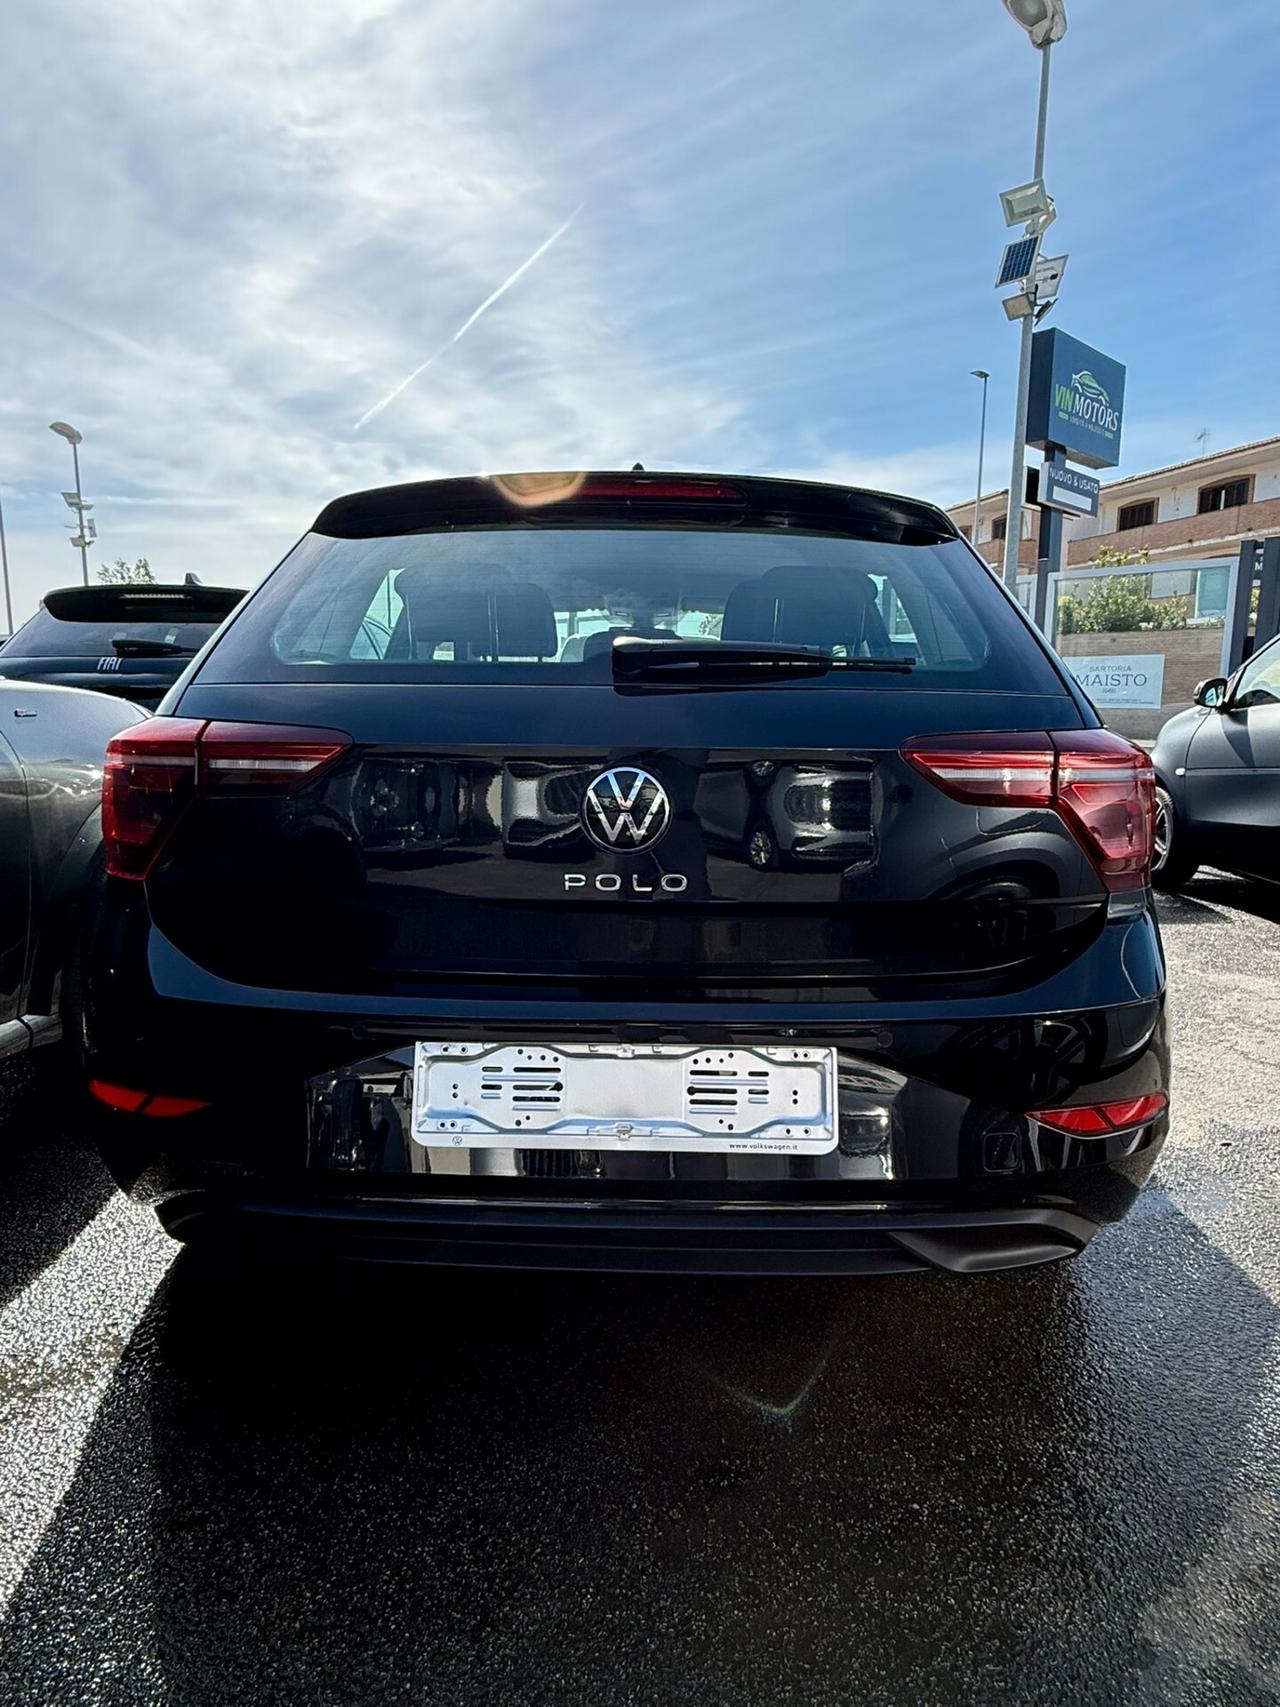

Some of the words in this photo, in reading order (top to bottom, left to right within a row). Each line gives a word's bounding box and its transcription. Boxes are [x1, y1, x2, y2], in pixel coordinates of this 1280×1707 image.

[1055, 384, 1074, 412] VIN
[1073, 394, 1119, 431] MOTORS
[1050, 467, 1072, 484] NUOVO
[1079, 479, 1098, 494] USATO
[97, 657, 122, 670] FIAT
[1076, 674, 1147, 687] MAISTO
[564, 874, 687, 892] POLO
[729, 1143, 798, 1151] www.volkswagen.it
